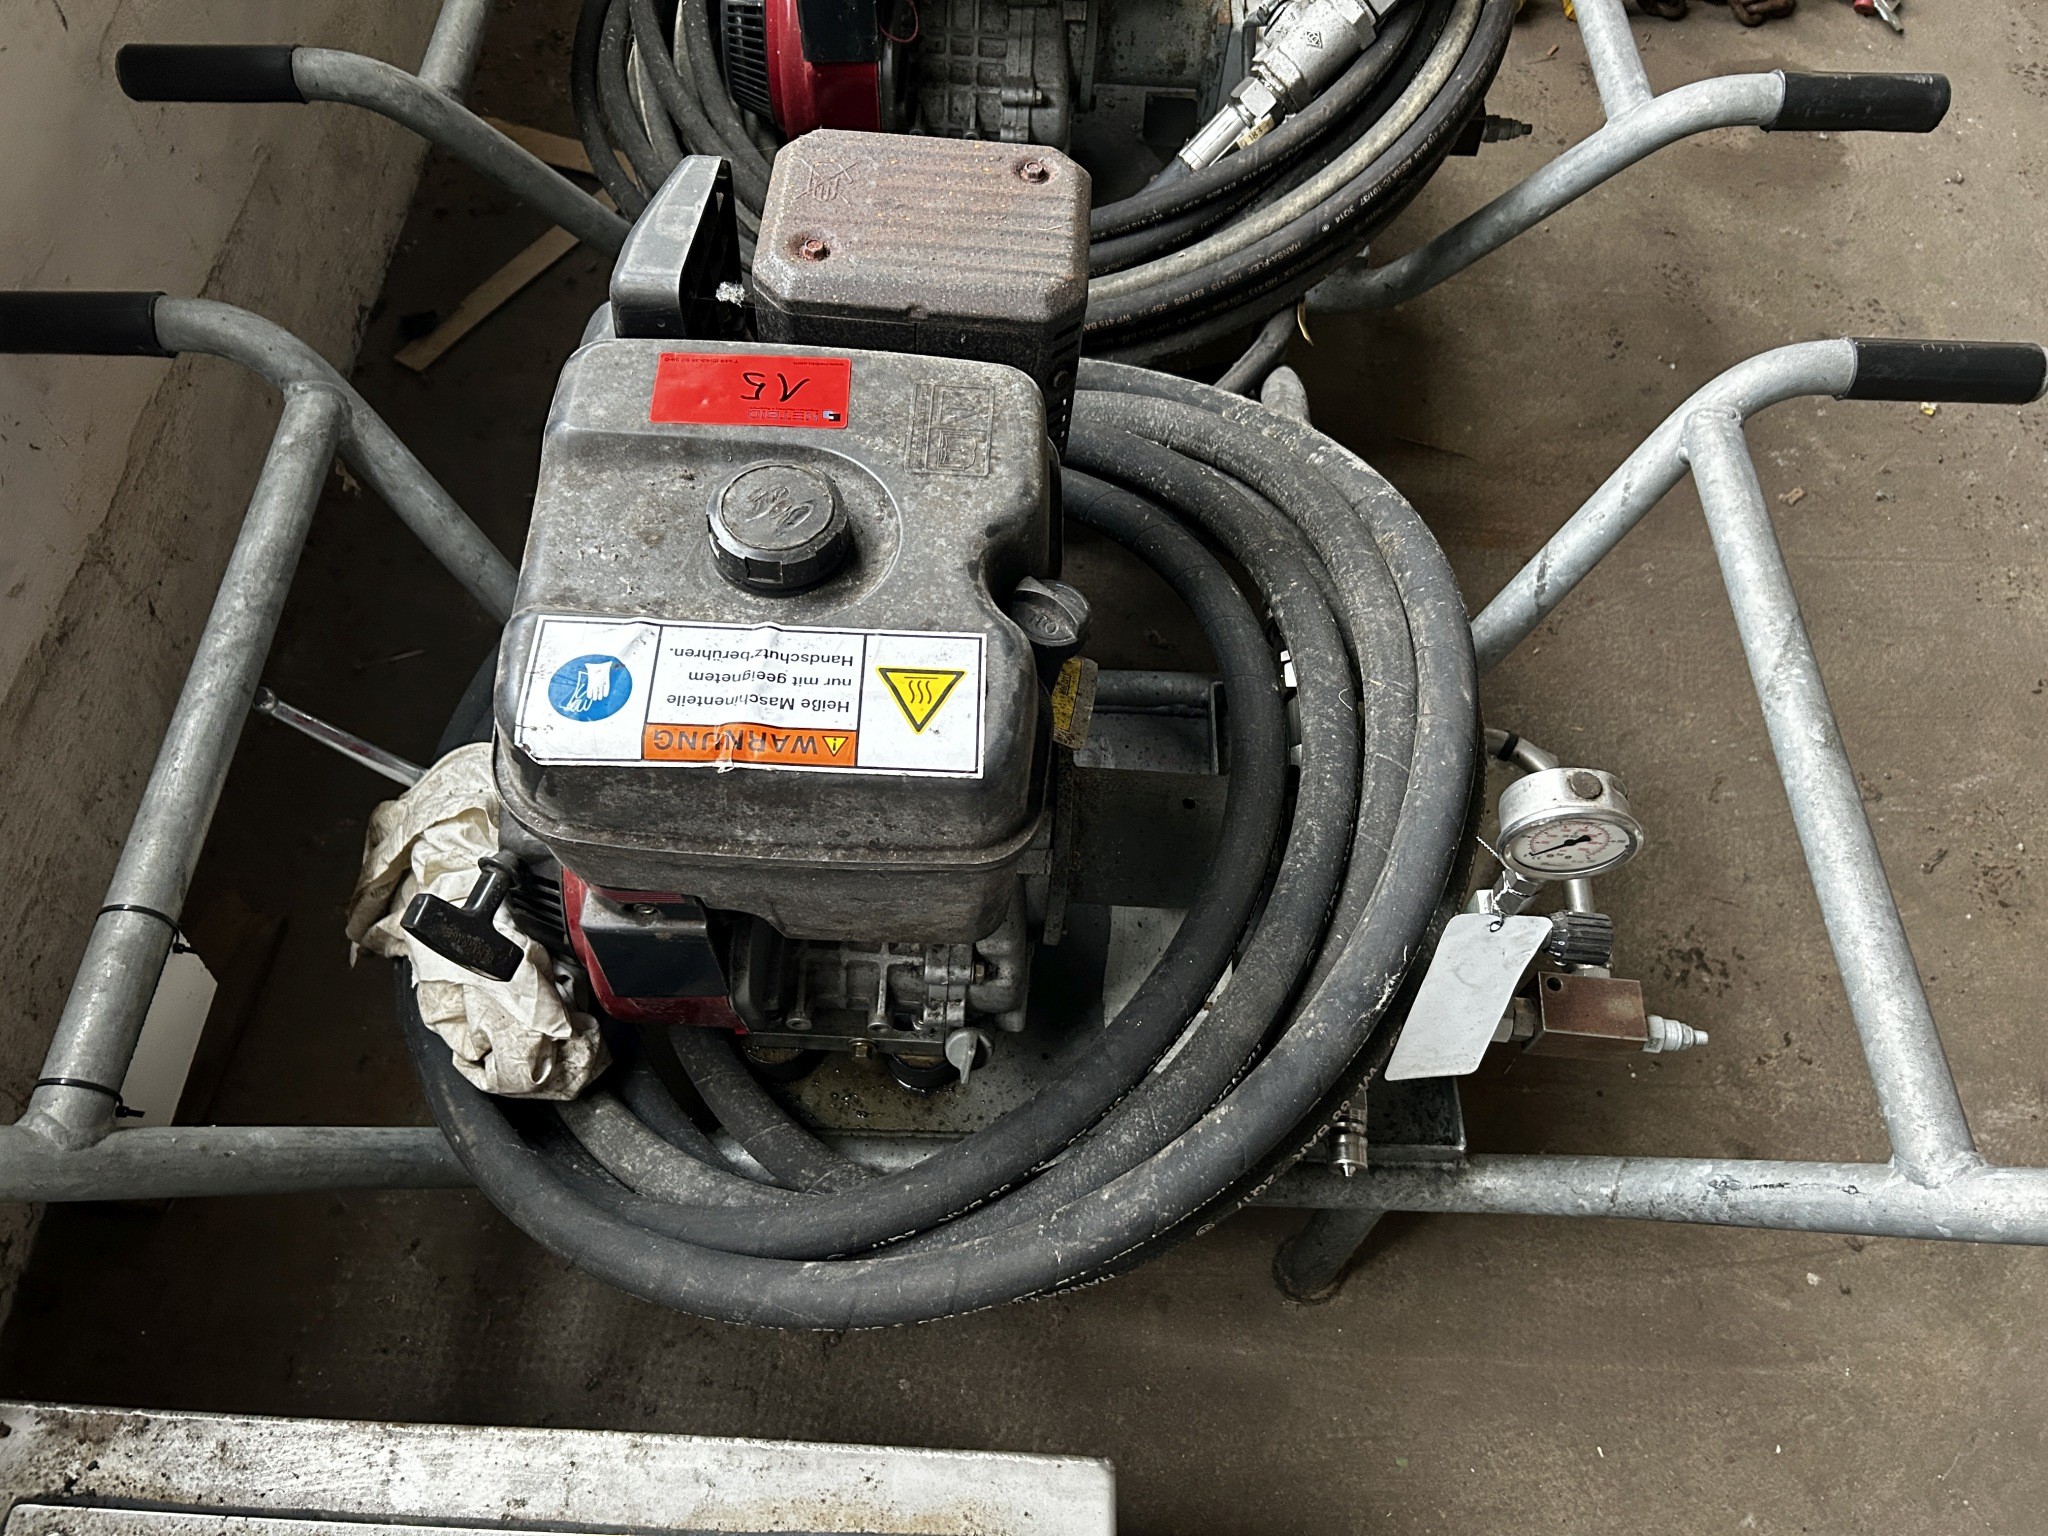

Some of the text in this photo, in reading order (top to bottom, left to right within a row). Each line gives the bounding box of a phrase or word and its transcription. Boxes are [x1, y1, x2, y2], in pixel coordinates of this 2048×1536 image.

[1246, 240, 1302, 275] HANSA-FLEX
[1227, 271, 1242, 283] HD
[1173, 293, 1190, 306] 856
[1190, 287, 1205, 299] EN
[1137, 308, 1147, 317] 12
[1148, 301, 1169, 314] 4SP
[1098, 317, 1115, 328] 415
[1116, 313, 1131, 323] WP
[740, 371, 810, 403] 15
[747, 409, 818, 421] NETBID
[687, 669, 851, 687] nur mit geeignetem
[665, 693, 849, 713] Heiße Maschinenteile
[651, 728, 817, 754] WARNUNG
